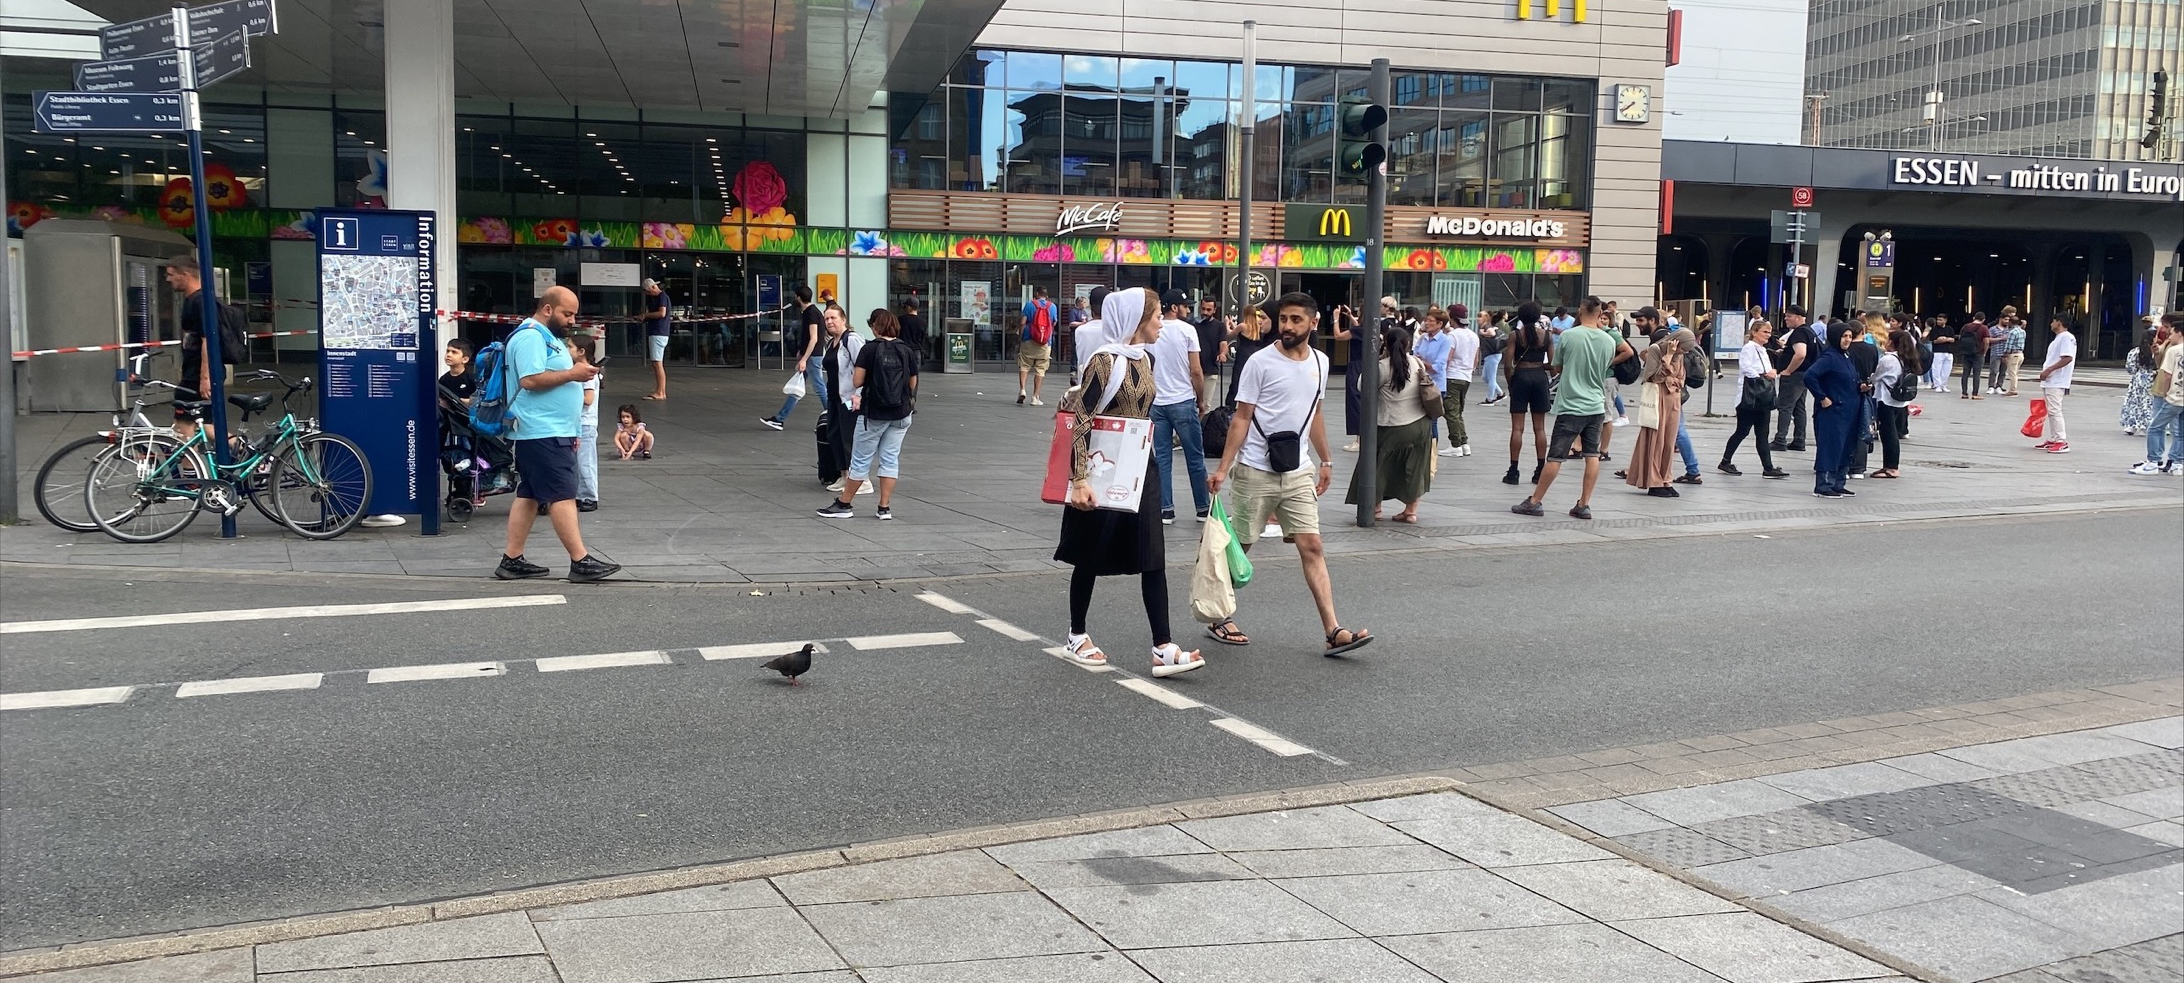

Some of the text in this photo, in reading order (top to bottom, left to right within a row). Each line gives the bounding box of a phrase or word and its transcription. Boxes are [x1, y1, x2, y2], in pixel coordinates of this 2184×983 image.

[51, 113, 92, 122] Bürgeramt
[1894, 157, 1978, 186] ESSEN
[2010, 163, 2089, 191] mitten
[2096, 167, 2119, 192] in
[1798, 192, 1807, 200] 58
[1426, 216, 1564, 238] McDonald's
[1886, 244, 1891, 257] 1
[418, 216, 434, 312] Information
[406, 420, 416, 500] www.visitessen.de
